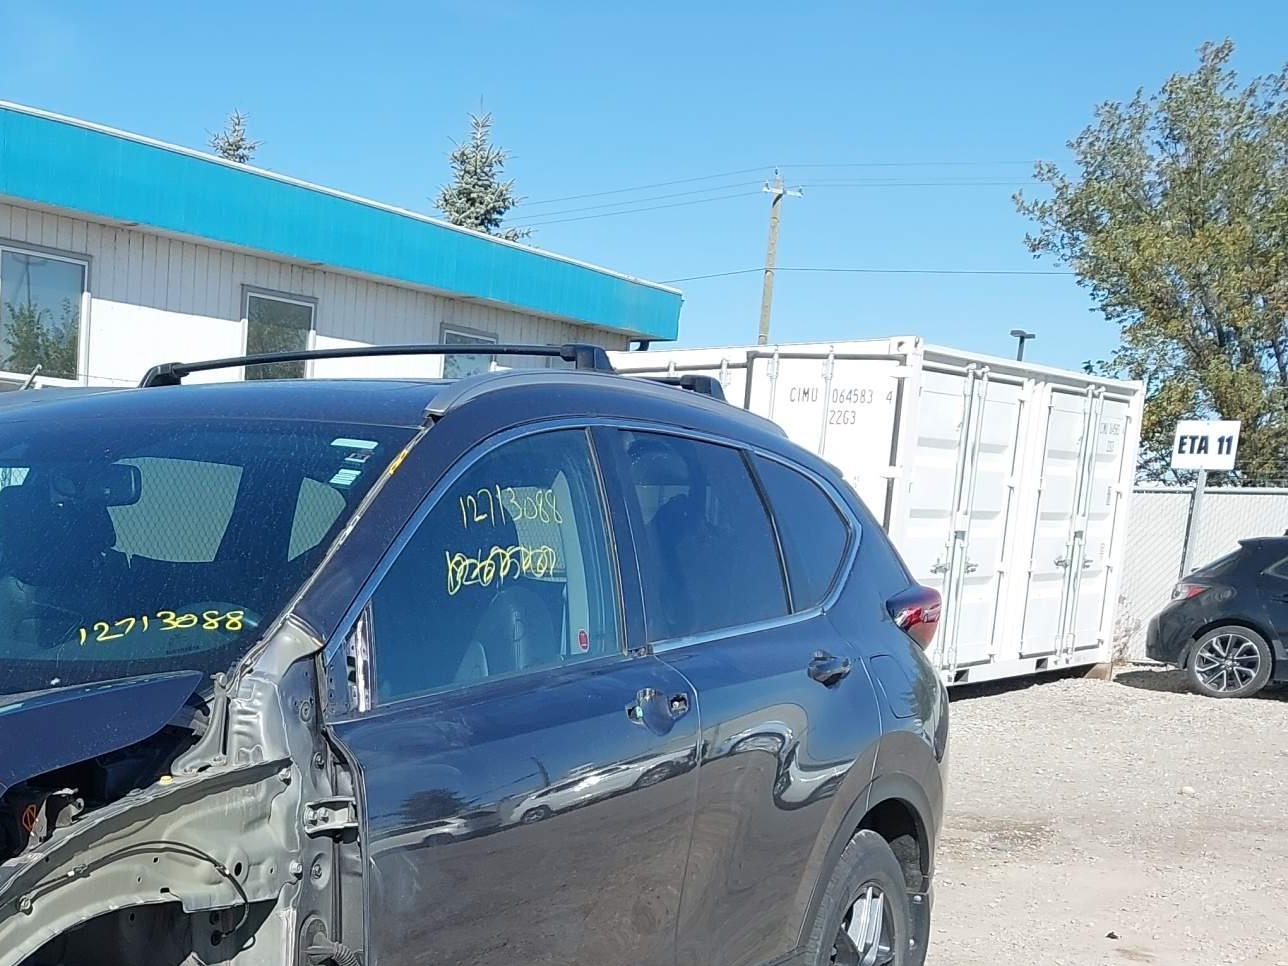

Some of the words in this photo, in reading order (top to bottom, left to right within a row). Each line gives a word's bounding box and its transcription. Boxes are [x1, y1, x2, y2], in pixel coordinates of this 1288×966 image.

[789, 387, 819, 403] CIMU
[831, 388, 873, 404] 064583
[885, 391, 893, 404] 4
[829, 410, 856, 425] 22G3
[1177, 435, 1209, 455] ETA
[1217, 435, 1234, 455] 11
[459, 484, 563, 528] 12713088
[79, 610, 245, 647] 12713088
